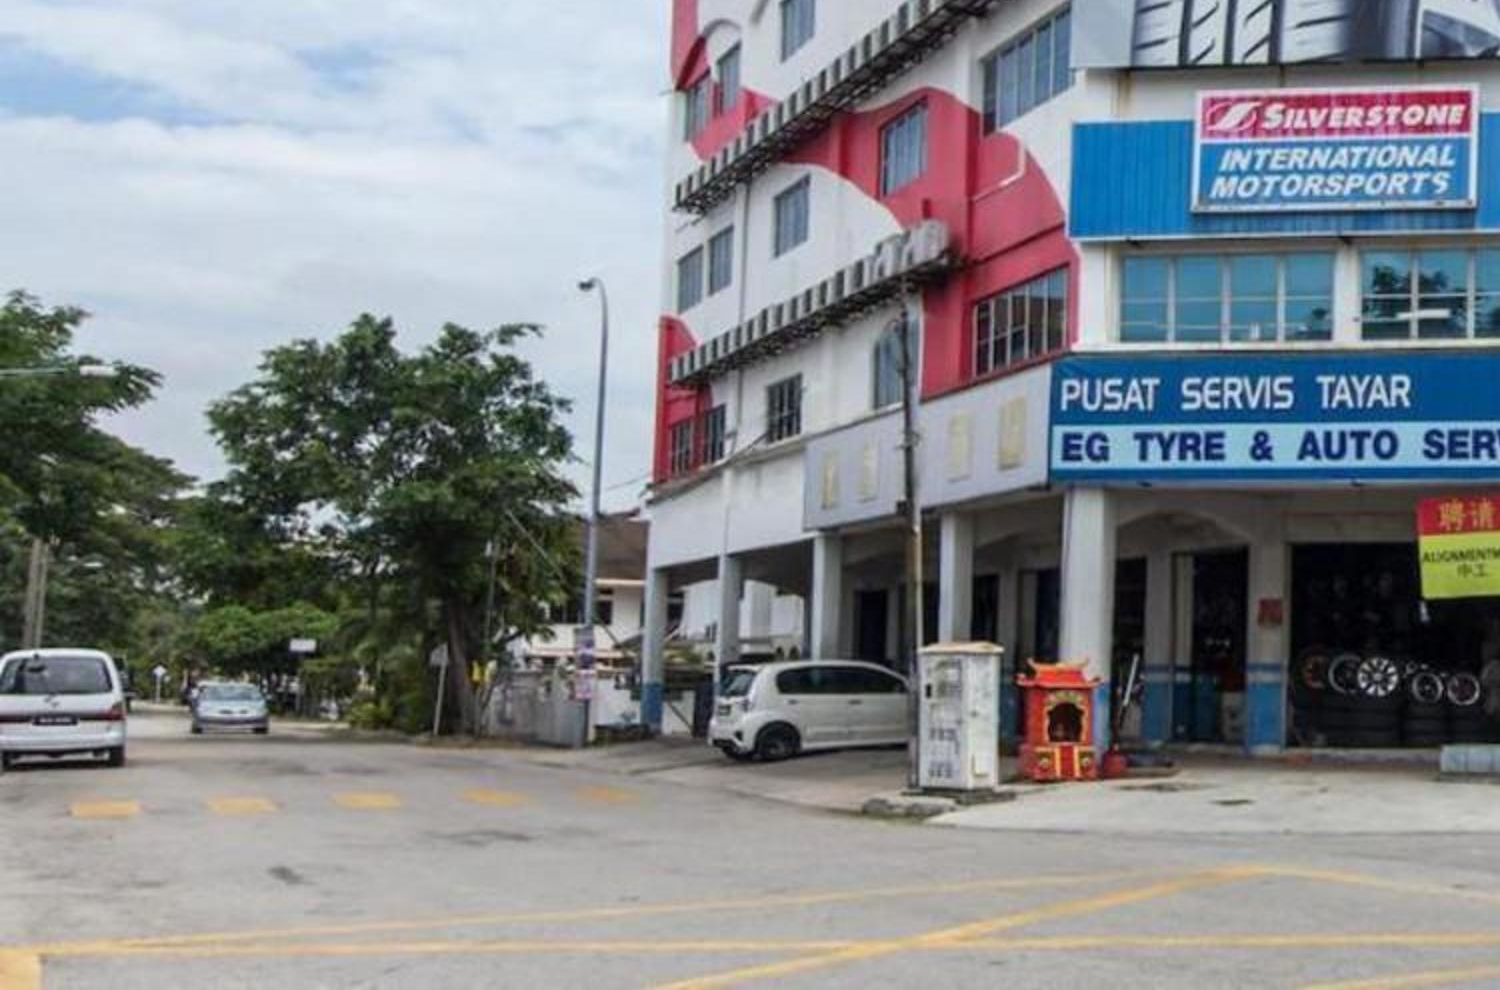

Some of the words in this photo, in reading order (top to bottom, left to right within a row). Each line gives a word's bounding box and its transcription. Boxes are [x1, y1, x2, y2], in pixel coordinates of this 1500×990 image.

[1262, 103, 1466, 130] SILVERSTONE
[1219, 144, 1456, 172] INTERNATIONAL
[1209, 172, 1450, 199] MOTORSPORTS
[1060, 377, 1160, 412] PUSAT
[1181, 376, 1295, 410] SERVIS
[1316, 374, 1412, 408] TAYAR
[1061, 431, 1110, 462] EG
[1133, 430, 1226, 461] TYRE
[1249, 429, 1274, 461] &
[1297, 428, 1399, 460] AUTO
